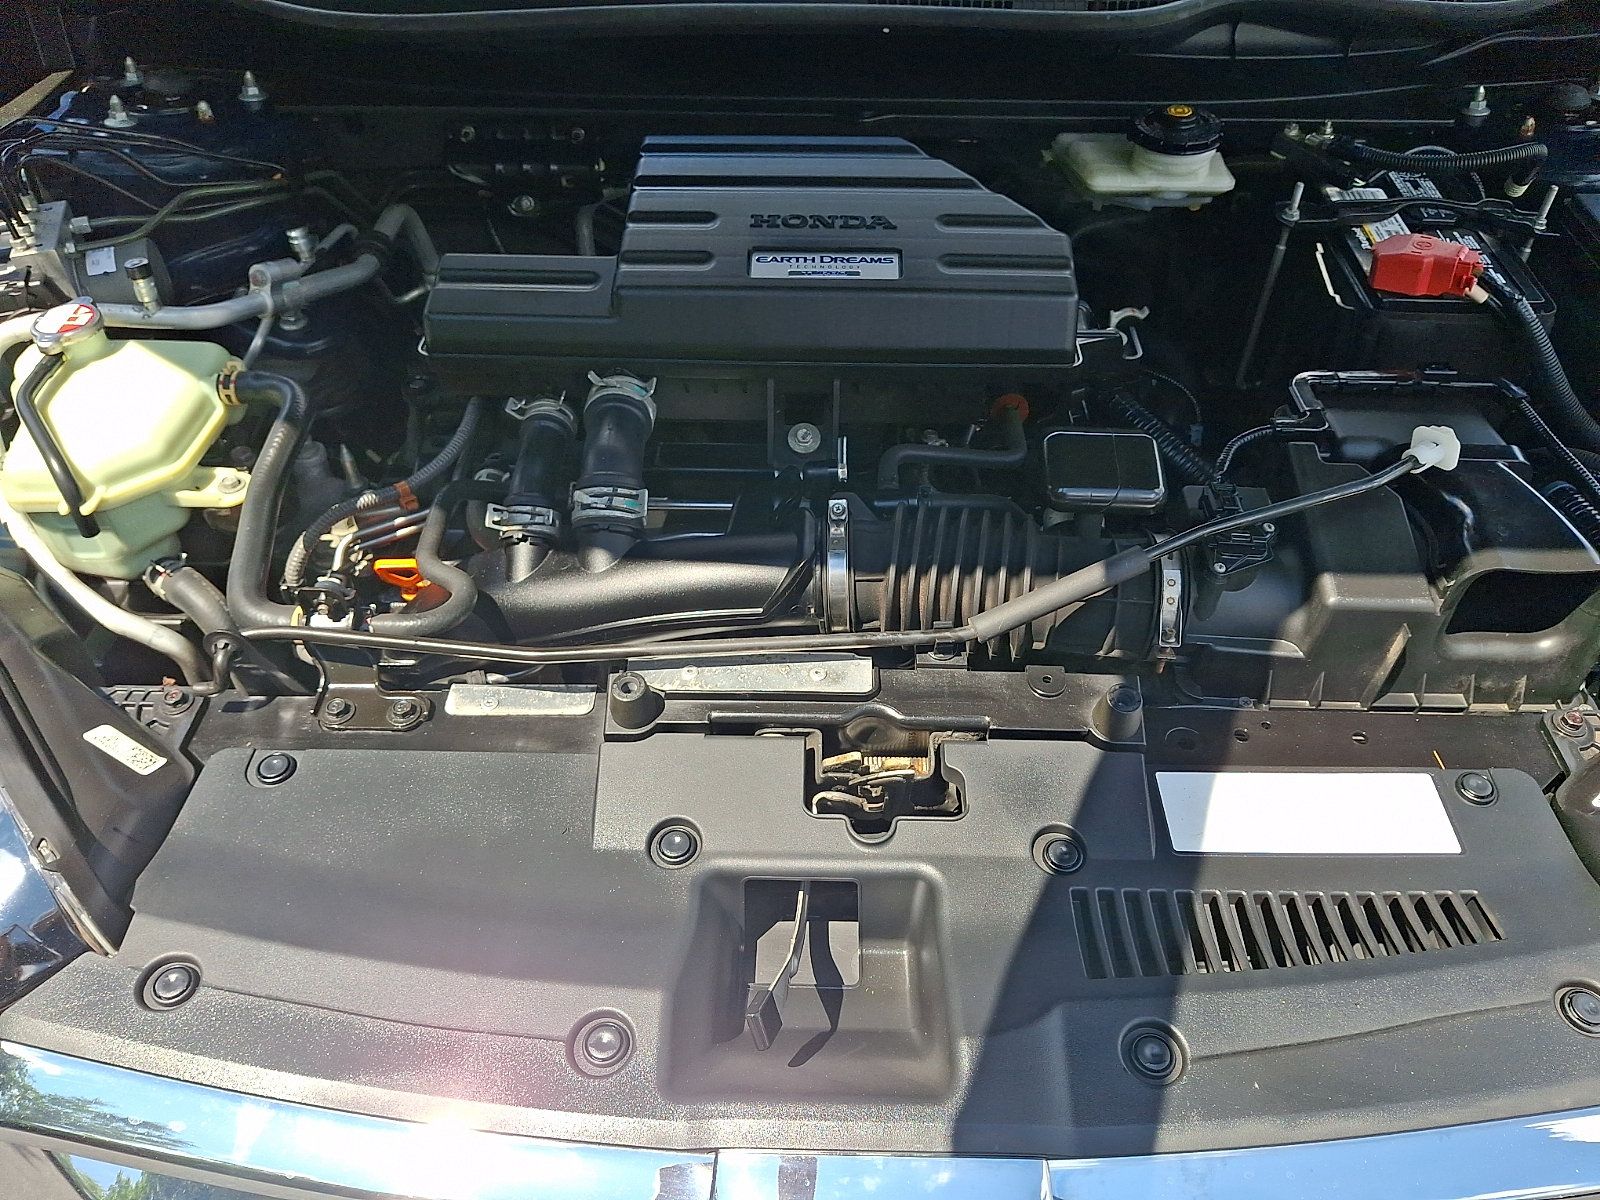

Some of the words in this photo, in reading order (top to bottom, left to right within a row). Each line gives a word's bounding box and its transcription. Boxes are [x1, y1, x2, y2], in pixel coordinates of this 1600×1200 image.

[750, 213, 898, 230] HONDA
[755, 255, 816, 264] EARTH
[819, 255, 894, 264] DREAMS
